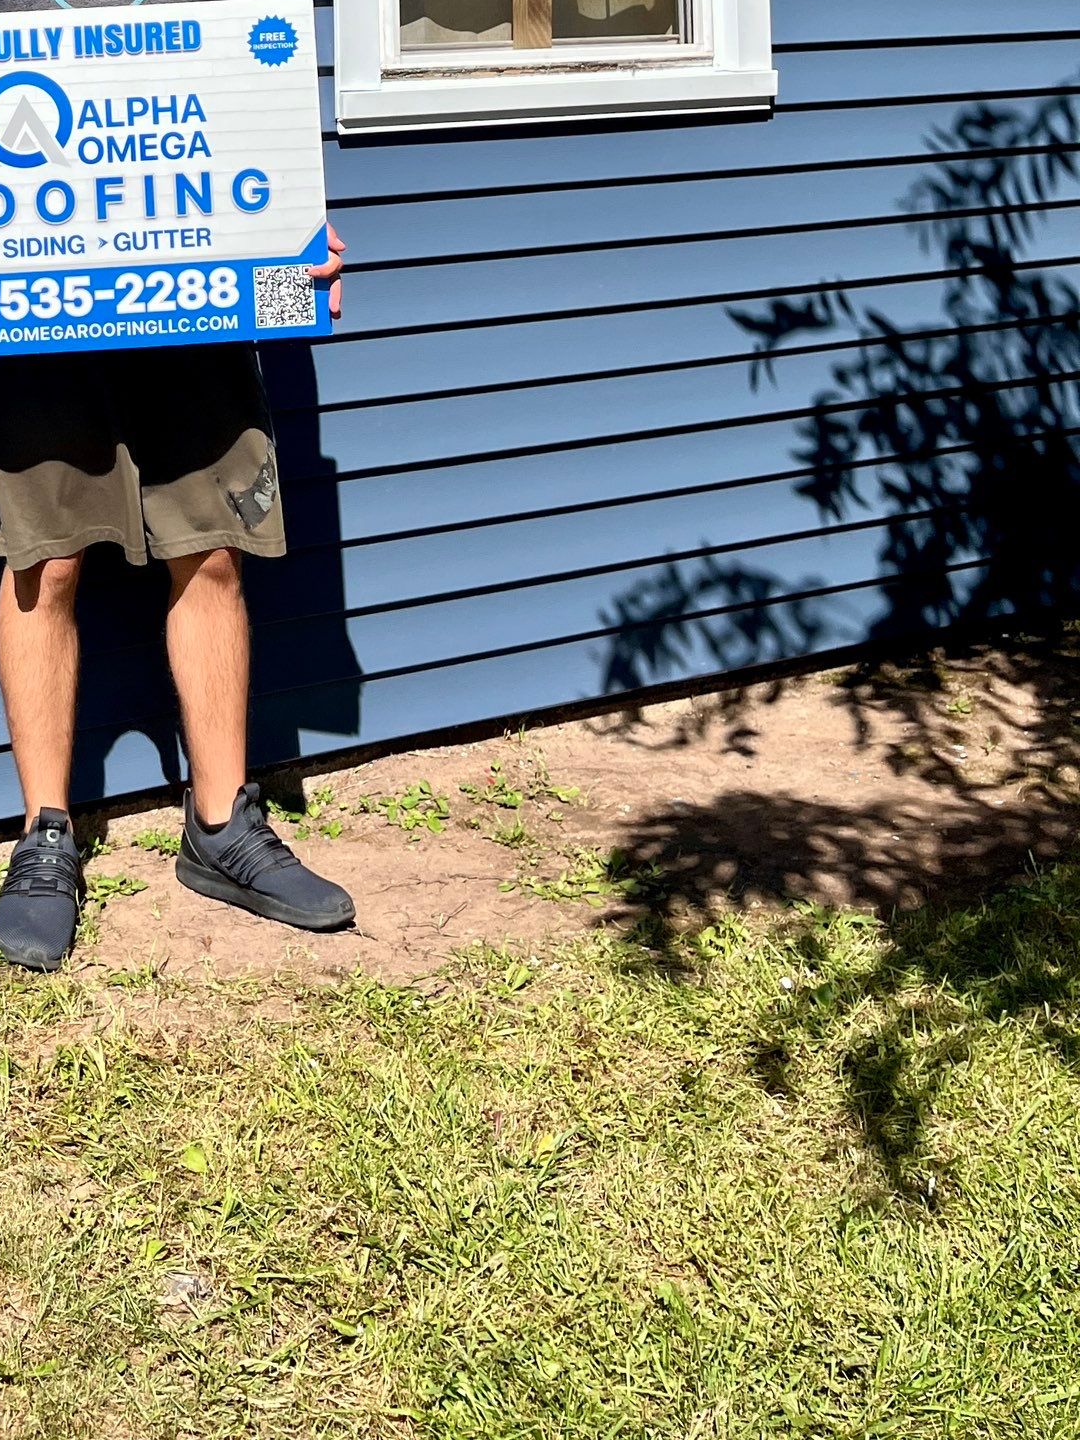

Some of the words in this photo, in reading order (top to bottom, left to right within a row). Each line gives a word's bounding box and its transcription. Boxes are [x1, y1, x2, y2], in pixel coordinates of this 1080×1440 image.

[73, 20, 201, 58] INSURED
[252, 42, 294, 50] INSPECTION
[259, 31, 286, 42] FREE
[77, 93, 207, 129] ALPHA
[78, 130, 212, 164] OMEGA
[3, 235, 86, 258] SIDING
[113, 228, 212, 252] GUTTER
